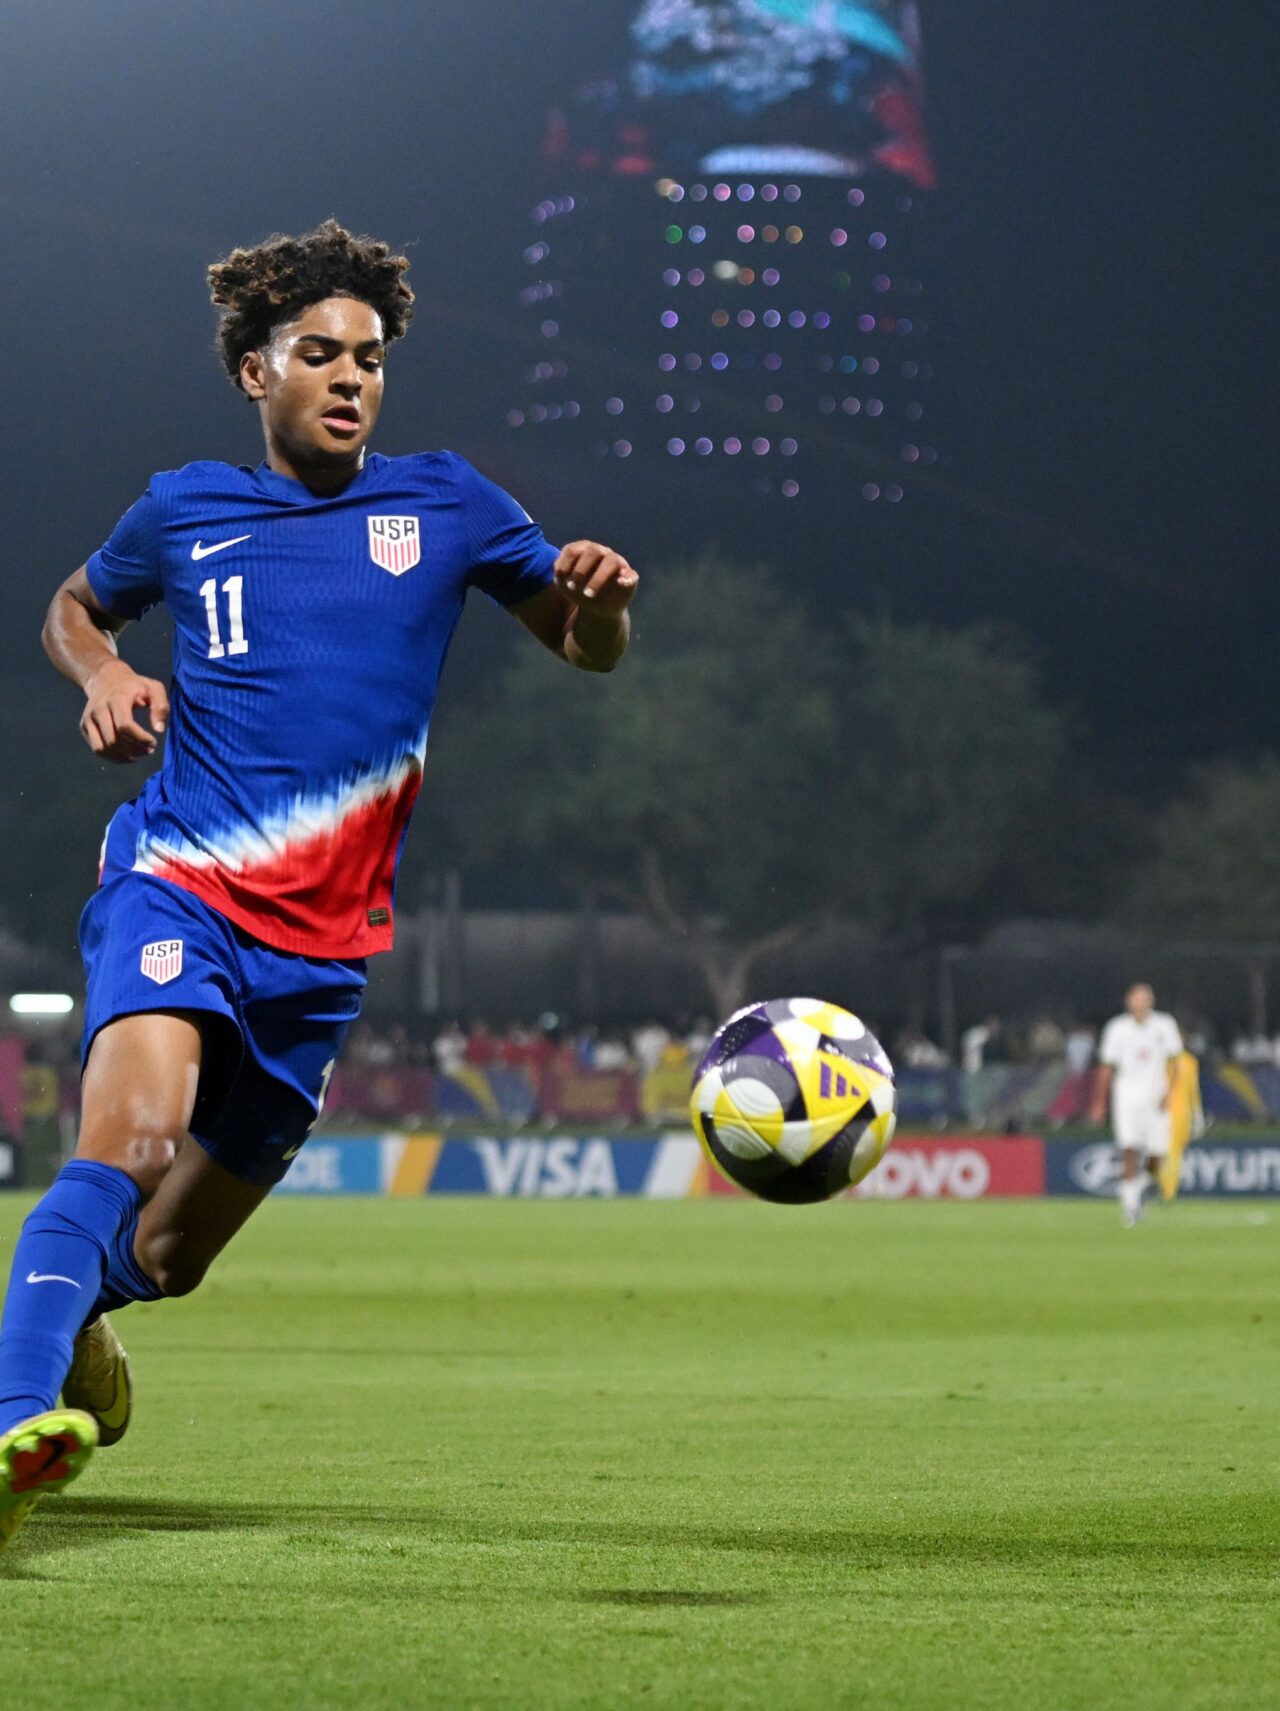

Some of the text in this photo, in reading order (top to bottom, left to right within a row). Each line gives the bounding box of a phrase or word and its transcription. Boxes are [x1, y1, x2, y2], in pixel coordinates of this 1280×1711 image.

[372, 518, 416, 541] USA
[199, 575, 249, 659] 11
[145, 942, 180, 958] USA
[474, 1138, 619, 1197] VISA
